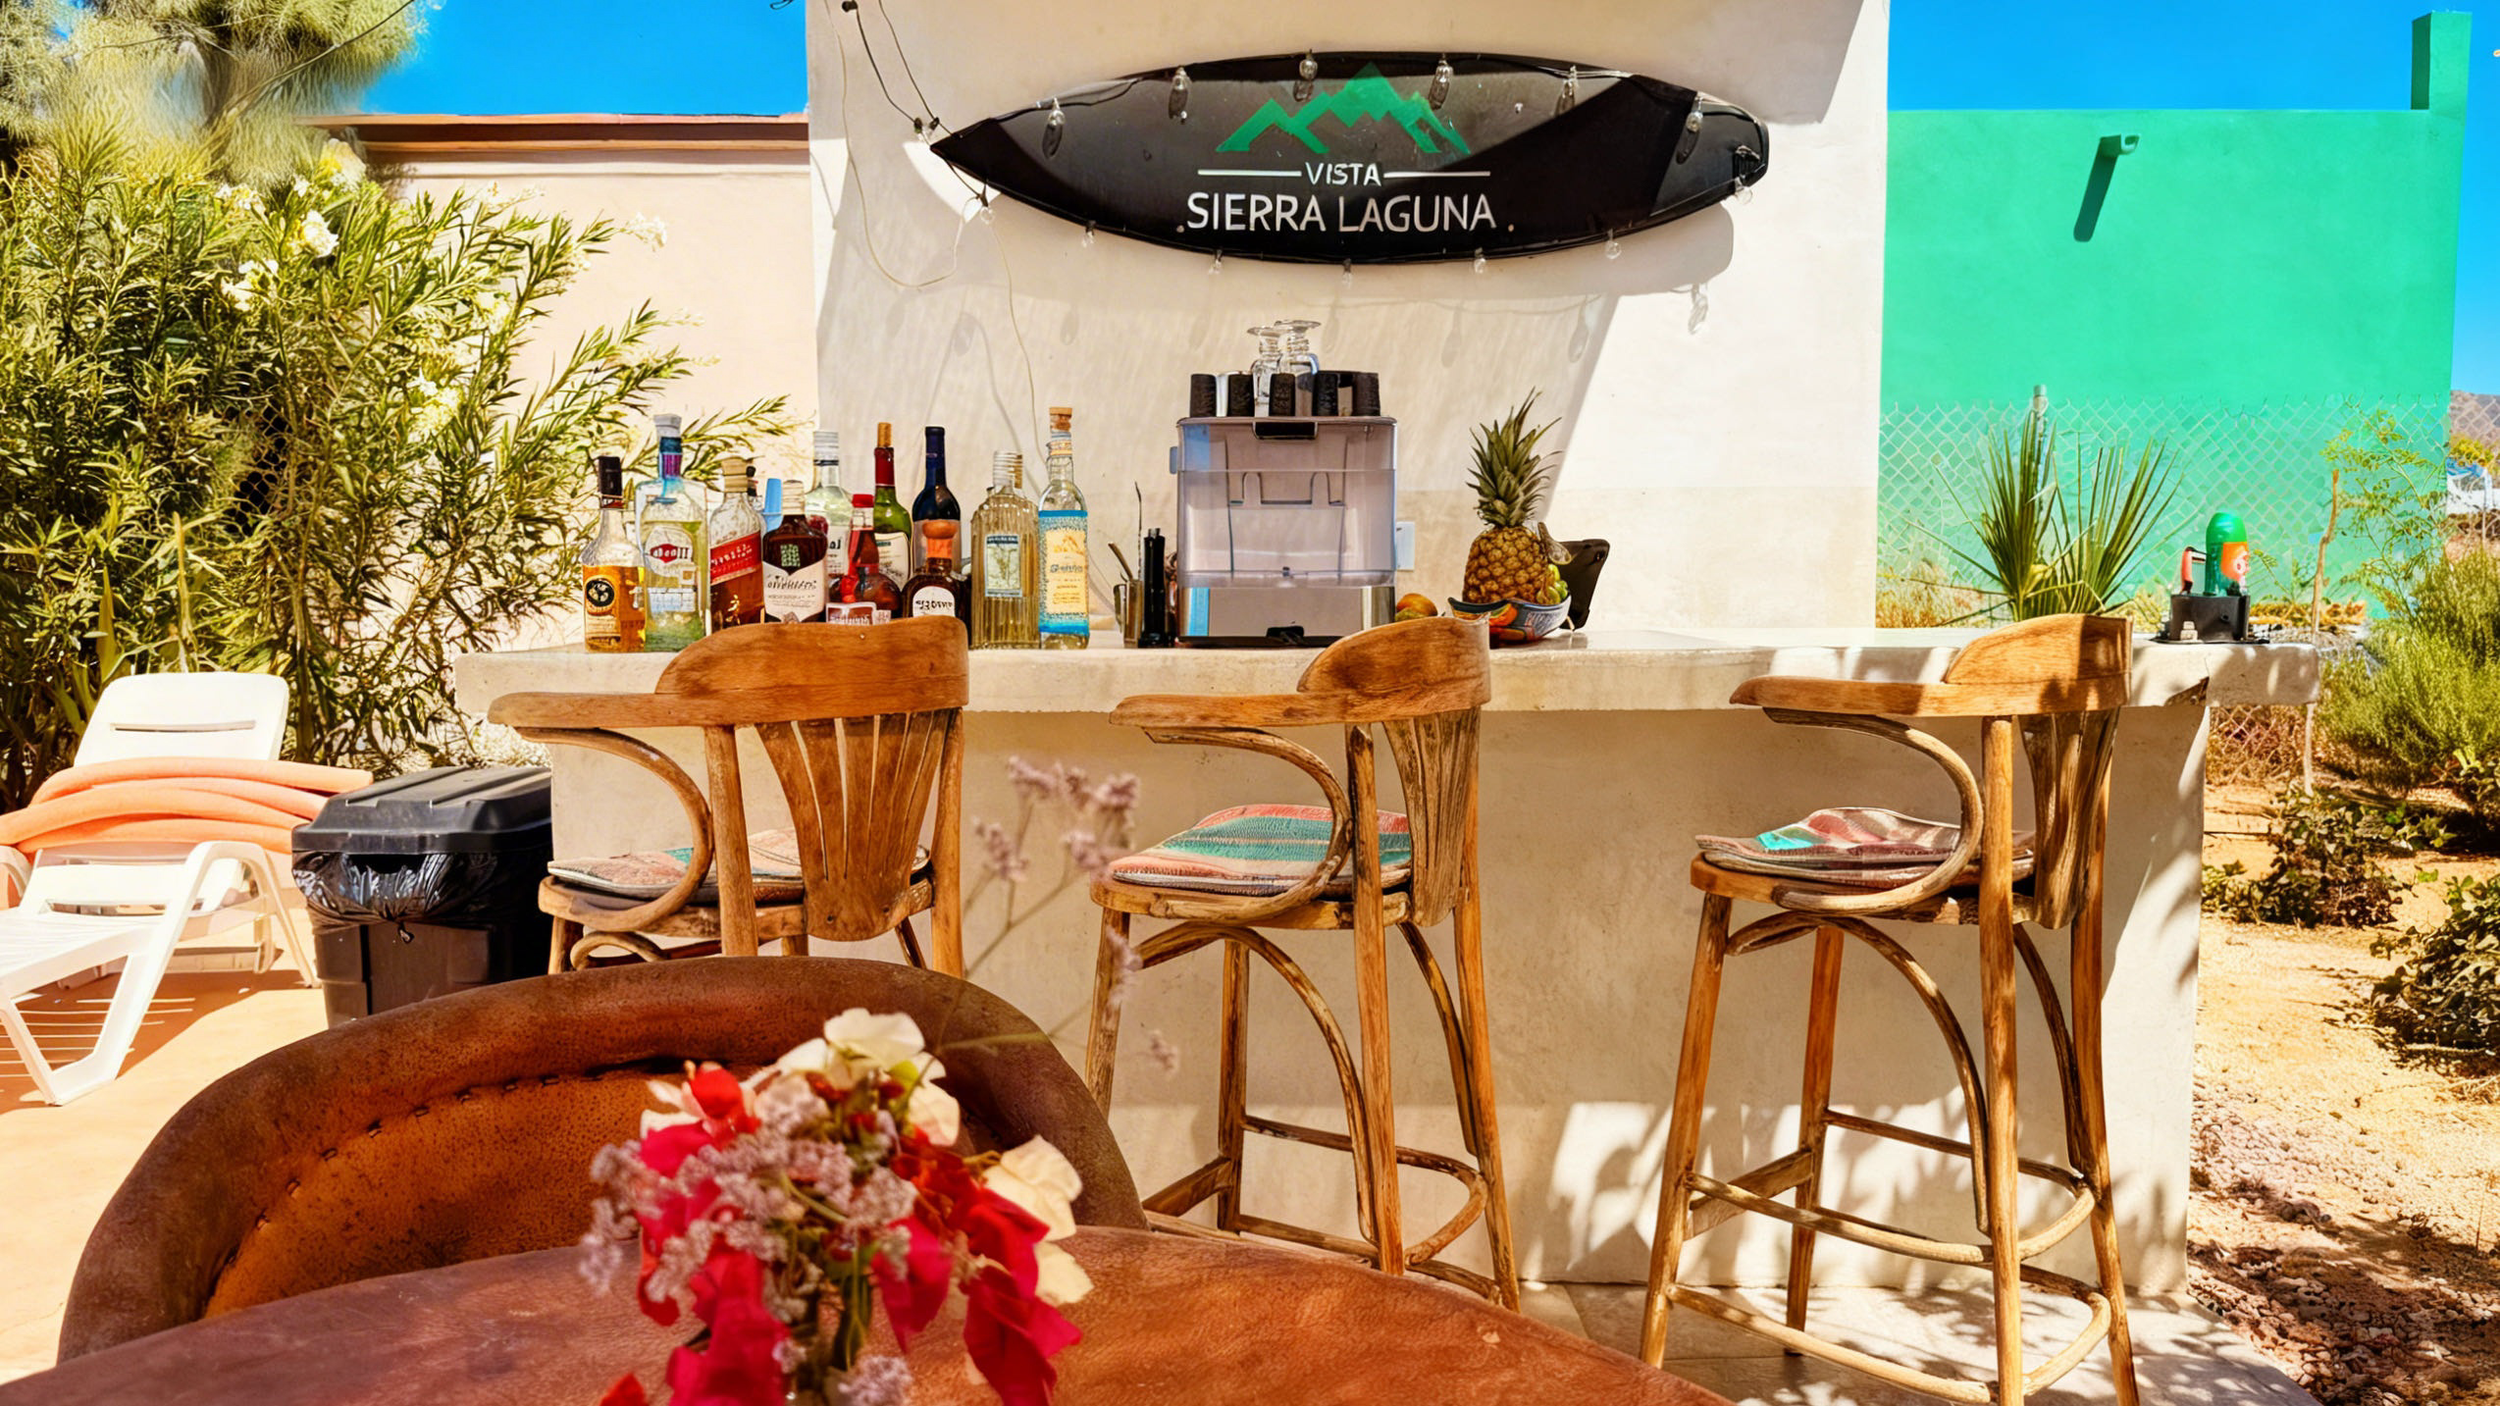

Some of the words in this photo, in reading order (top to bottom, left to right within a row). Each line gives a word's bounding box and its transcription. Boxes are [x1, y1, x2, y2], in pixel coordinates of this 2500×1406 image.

[1306, 162, 1382, 186] VISTA
[1186, 192, 1326, 232] SIERRA
[1338, 193, 1497, 233] LAGUNA
